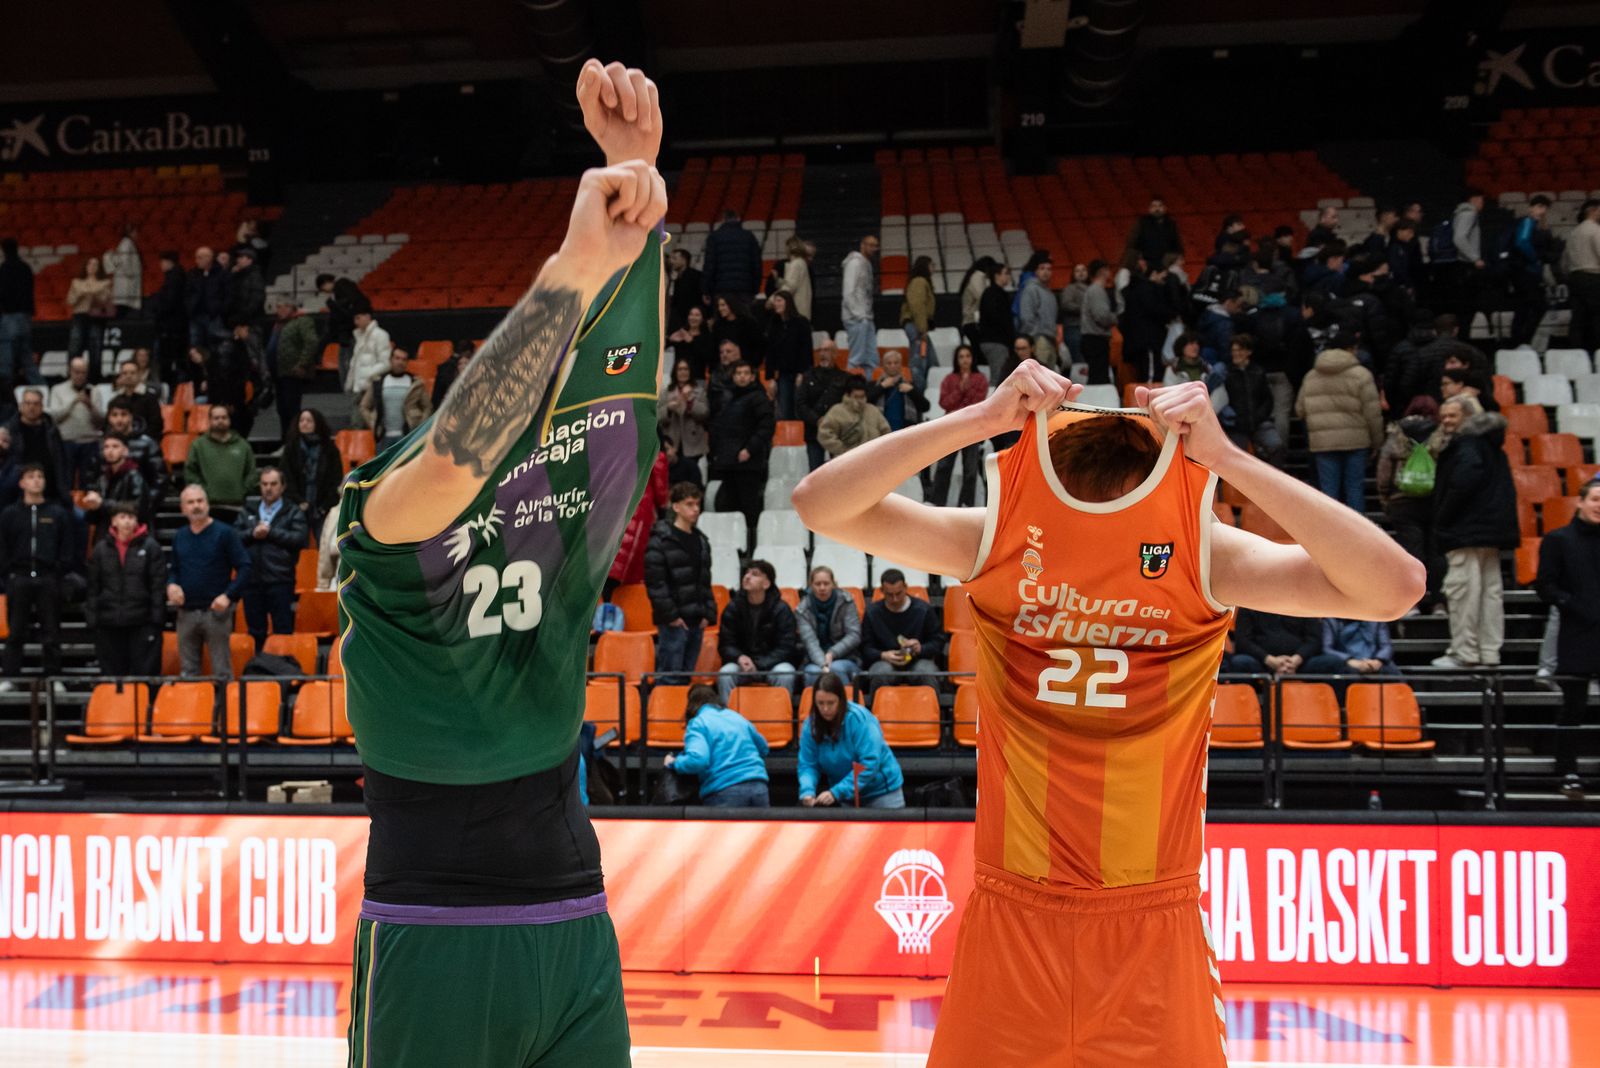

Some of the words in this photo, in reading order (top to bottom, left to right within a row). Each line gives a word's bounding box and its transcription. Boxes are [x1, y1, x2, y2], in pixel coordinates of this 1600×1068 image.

[607, 345, 637, 357] LIGA
[538, 507, 553, 523] la
[1142, 545, 1171, 556] LIGA
[462, 559, 543, 639] 23
[1018, 578, 1138, 617] Cultura
[1036, 647, 1129, 708] 22
[85, 835, 228, 942] BASKET
[239, 836, 337, 944] CLUB
[1266, 848, 1437, 965] BASKET
[1451, 848, 1567, 967] CLUB
